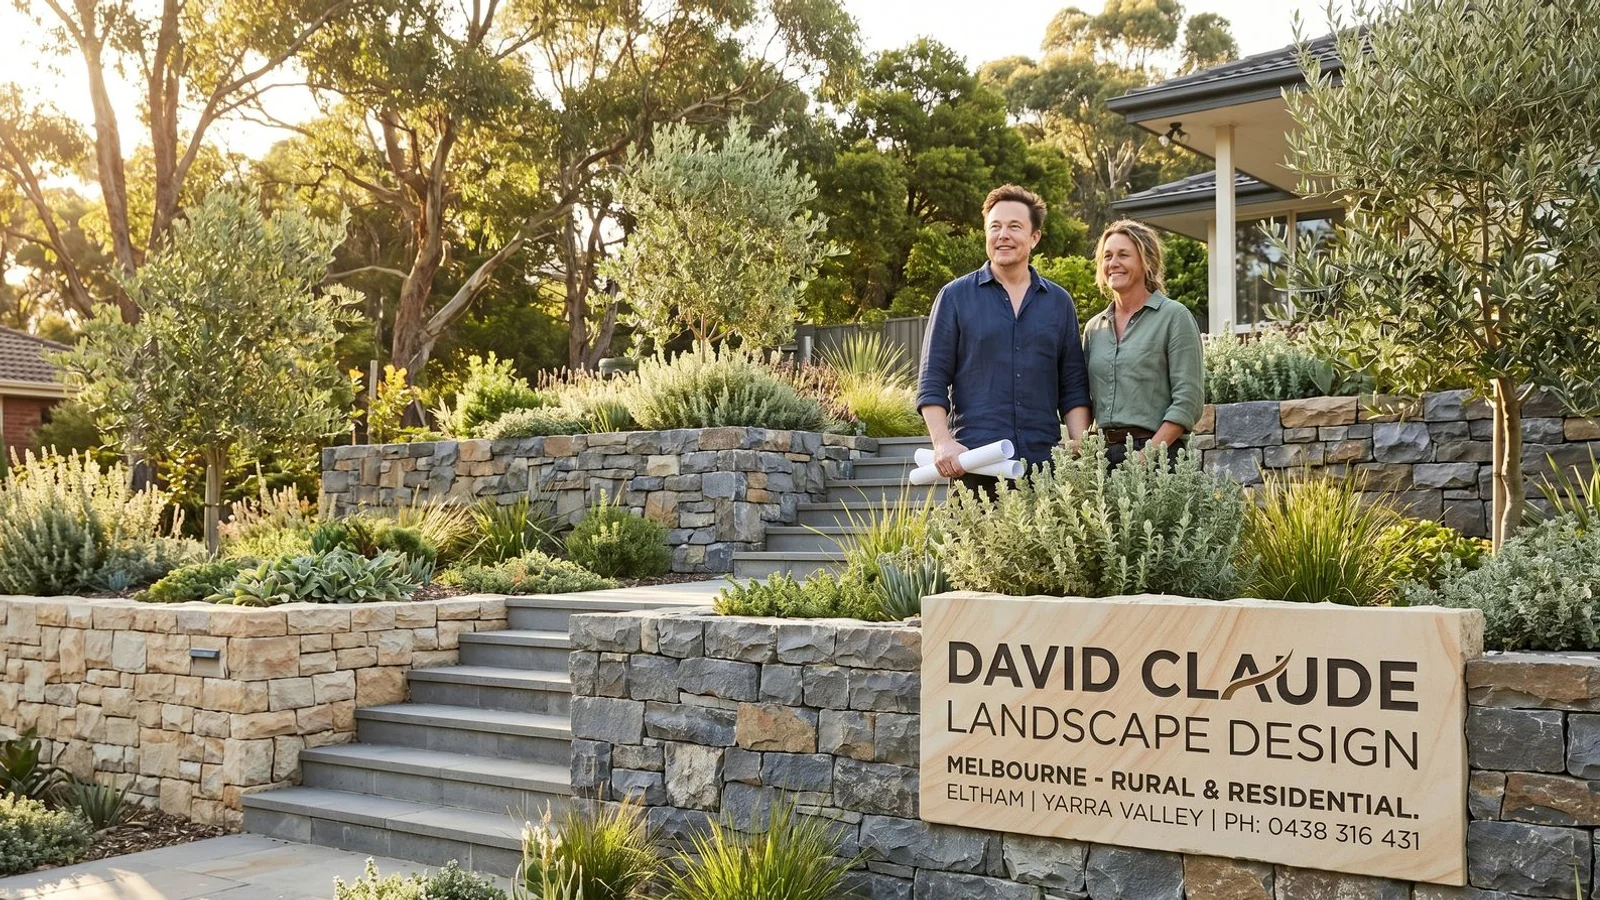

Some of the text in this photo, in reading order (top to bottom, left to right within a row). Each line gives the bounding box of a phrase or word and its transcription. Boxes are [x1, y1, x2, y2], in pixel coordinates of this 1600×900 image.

[948, 640, 1419, 713] DAVID CLAUDE
[947, 700, 1419, 771] LANDSCAPE DESIGN
[947, 755, 1087, 788] MELBOURNE
[1111, 770, 1196, 798] RURAL
[1202, 779, 1220, 801] &
[1228, 781, 1420, 820] RESIDENTIAL.
[947, 783, 1024, 808] ELTHAM
[1042, 793, 1113, 818] YARRA
[1120, 802, 1204, 827] VALLEY
[1225, 812, 1261, 834] PH:
[1268, 817, 1328, 841] 0438
[1335, 824, 1373, 846] 316
[1380, 829, 1420, 851] 431
